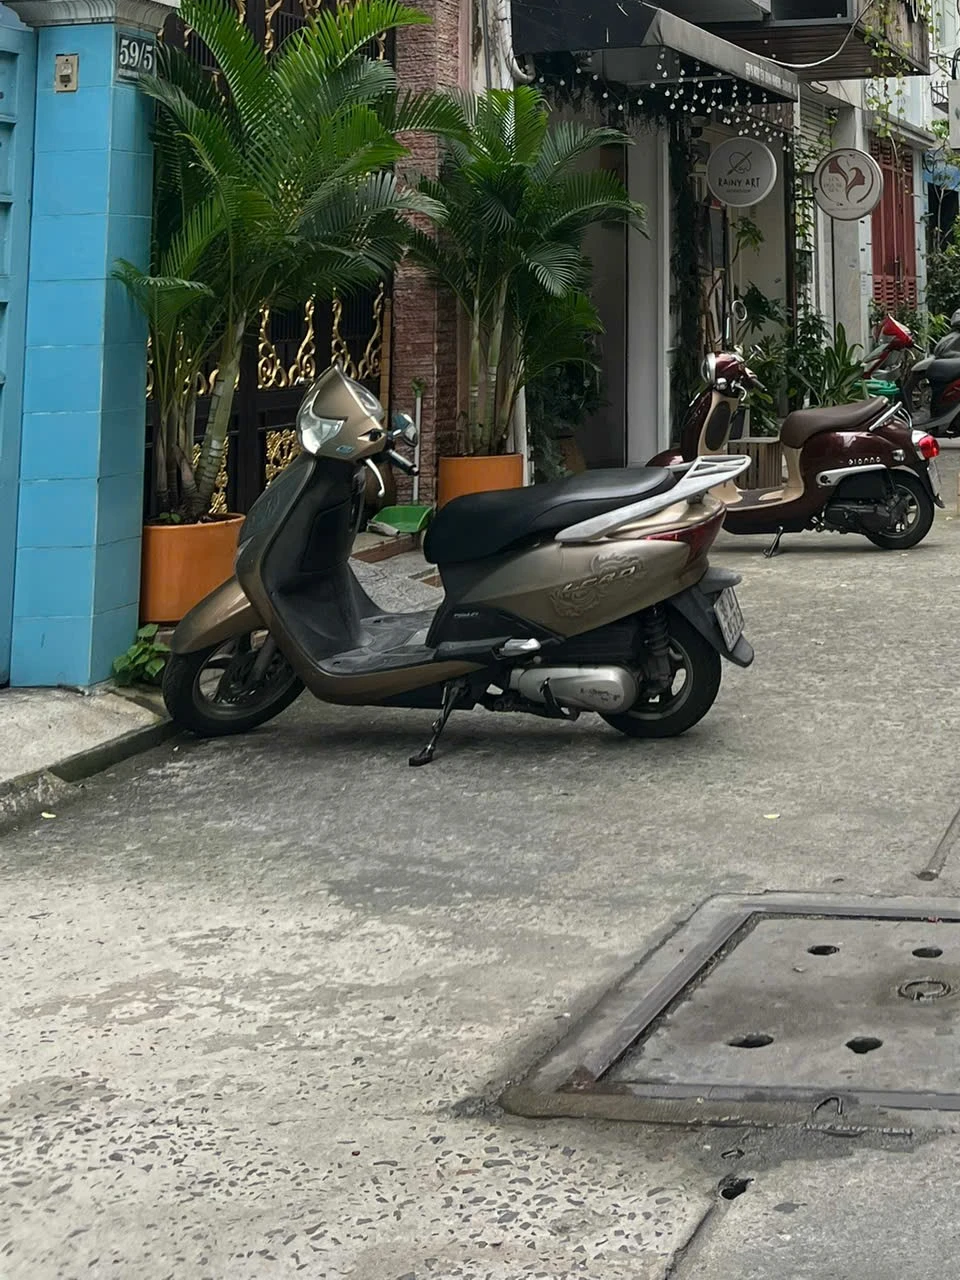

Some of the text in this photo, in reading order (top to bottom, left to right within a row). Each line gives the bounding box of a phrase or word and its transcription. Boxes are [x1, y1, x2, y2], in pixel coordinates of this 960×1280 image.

[118, 38, 154, 70] 59/5
[718, 176, 760, 188] RAINY ART
